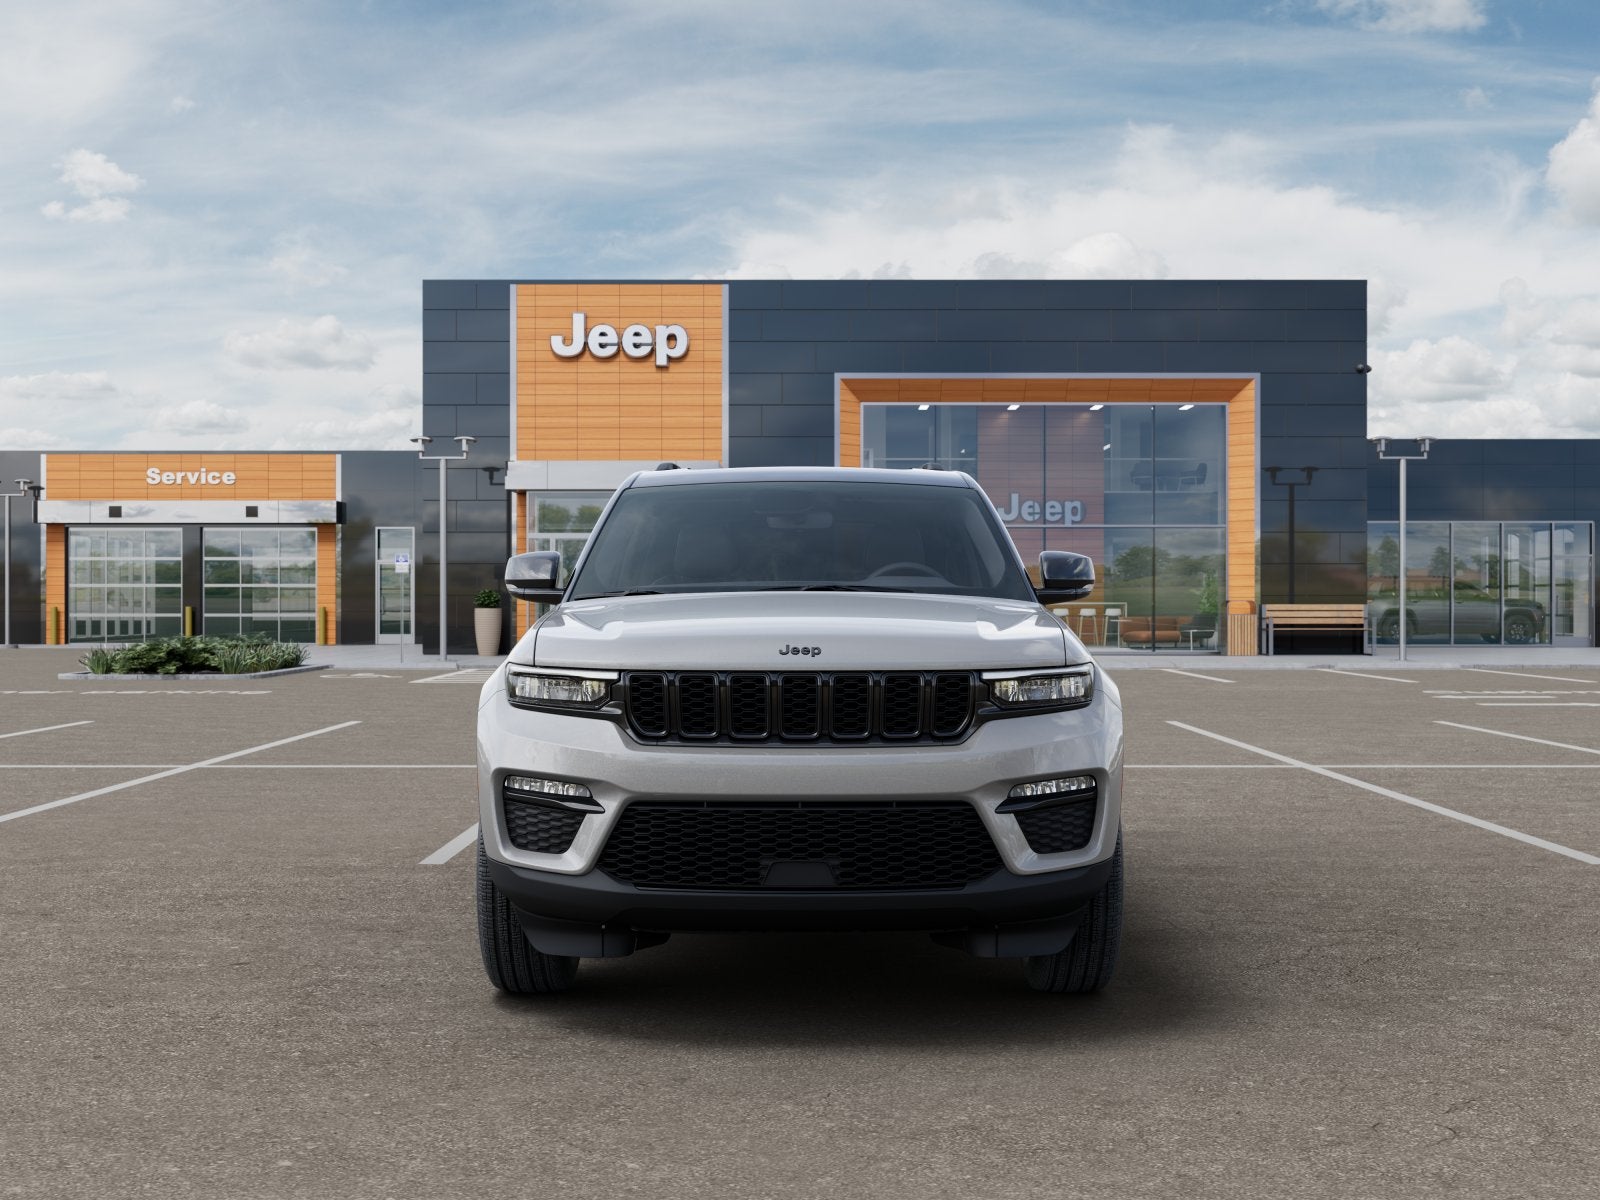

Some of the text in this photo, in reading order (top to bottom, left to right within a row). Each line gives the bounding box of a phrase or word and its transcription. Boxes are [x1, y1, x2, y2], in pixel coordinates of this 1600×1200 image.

[550, 312, 689, 367] Jeep
[146, 467, 236, 485] Service
[997, 493, 1084, 526] Jeep
[779, 644, 822, 657] Jeep
